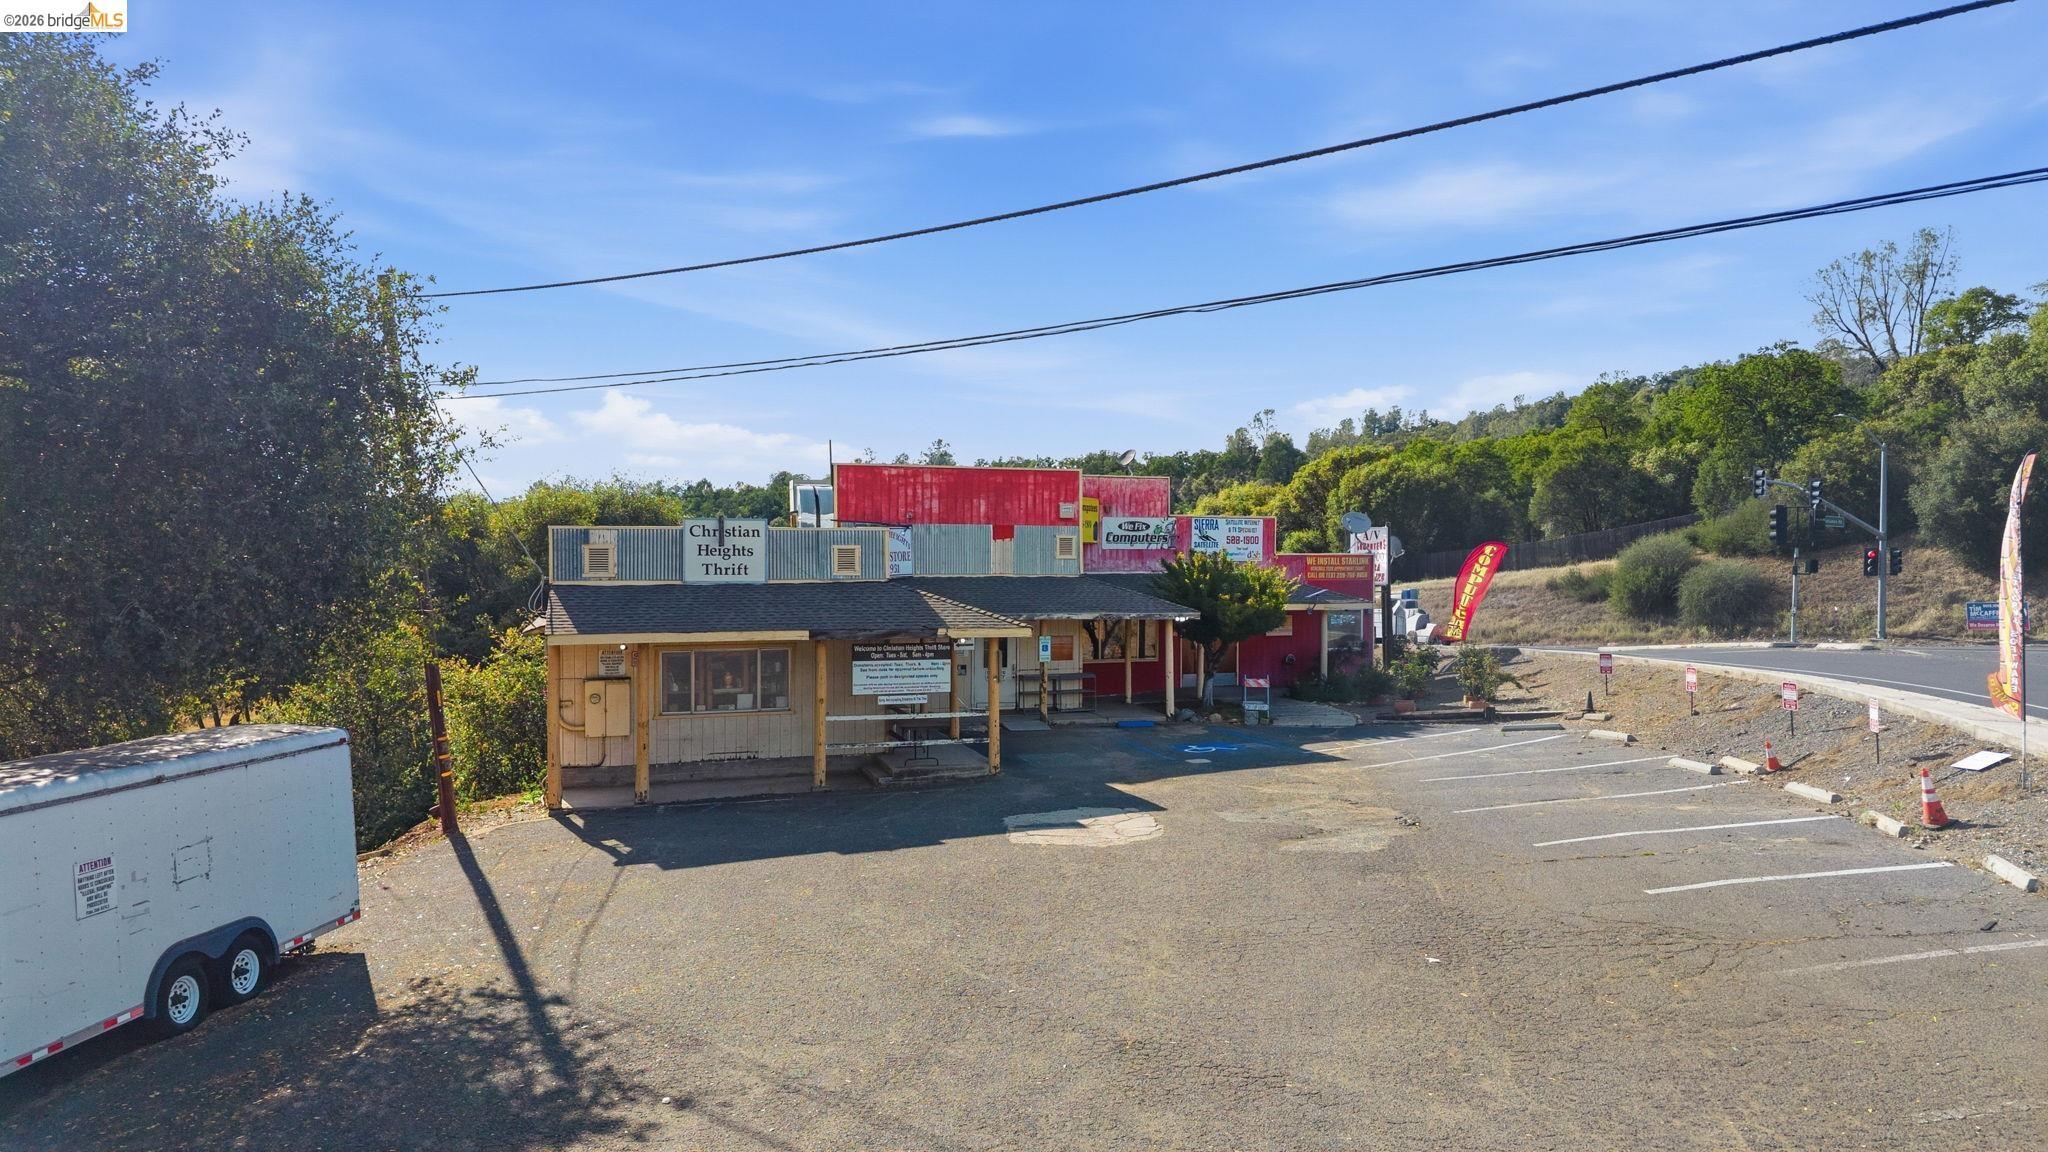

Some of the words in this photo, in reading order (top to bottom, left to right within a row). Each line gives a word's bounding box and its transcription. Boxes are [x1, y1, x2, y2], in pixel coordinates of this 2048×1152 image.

[689, 524, 761, 538] Chrstian
[1194, 519, 1219, 531] SIERRA
[1105, 532, 1169, 546] Computers
[1193, 541, 1219, 549] SATELLITE
[697, 544, 754, 561] Heights
[890, 551, 911, 562] STORE
[1306, 556, 1316, 565] WE
[1317, 556, 1340, 565] INSTALL
[701, 563, 749, 576] Thrift
[79, 856, 112, 873] ATTENTION
